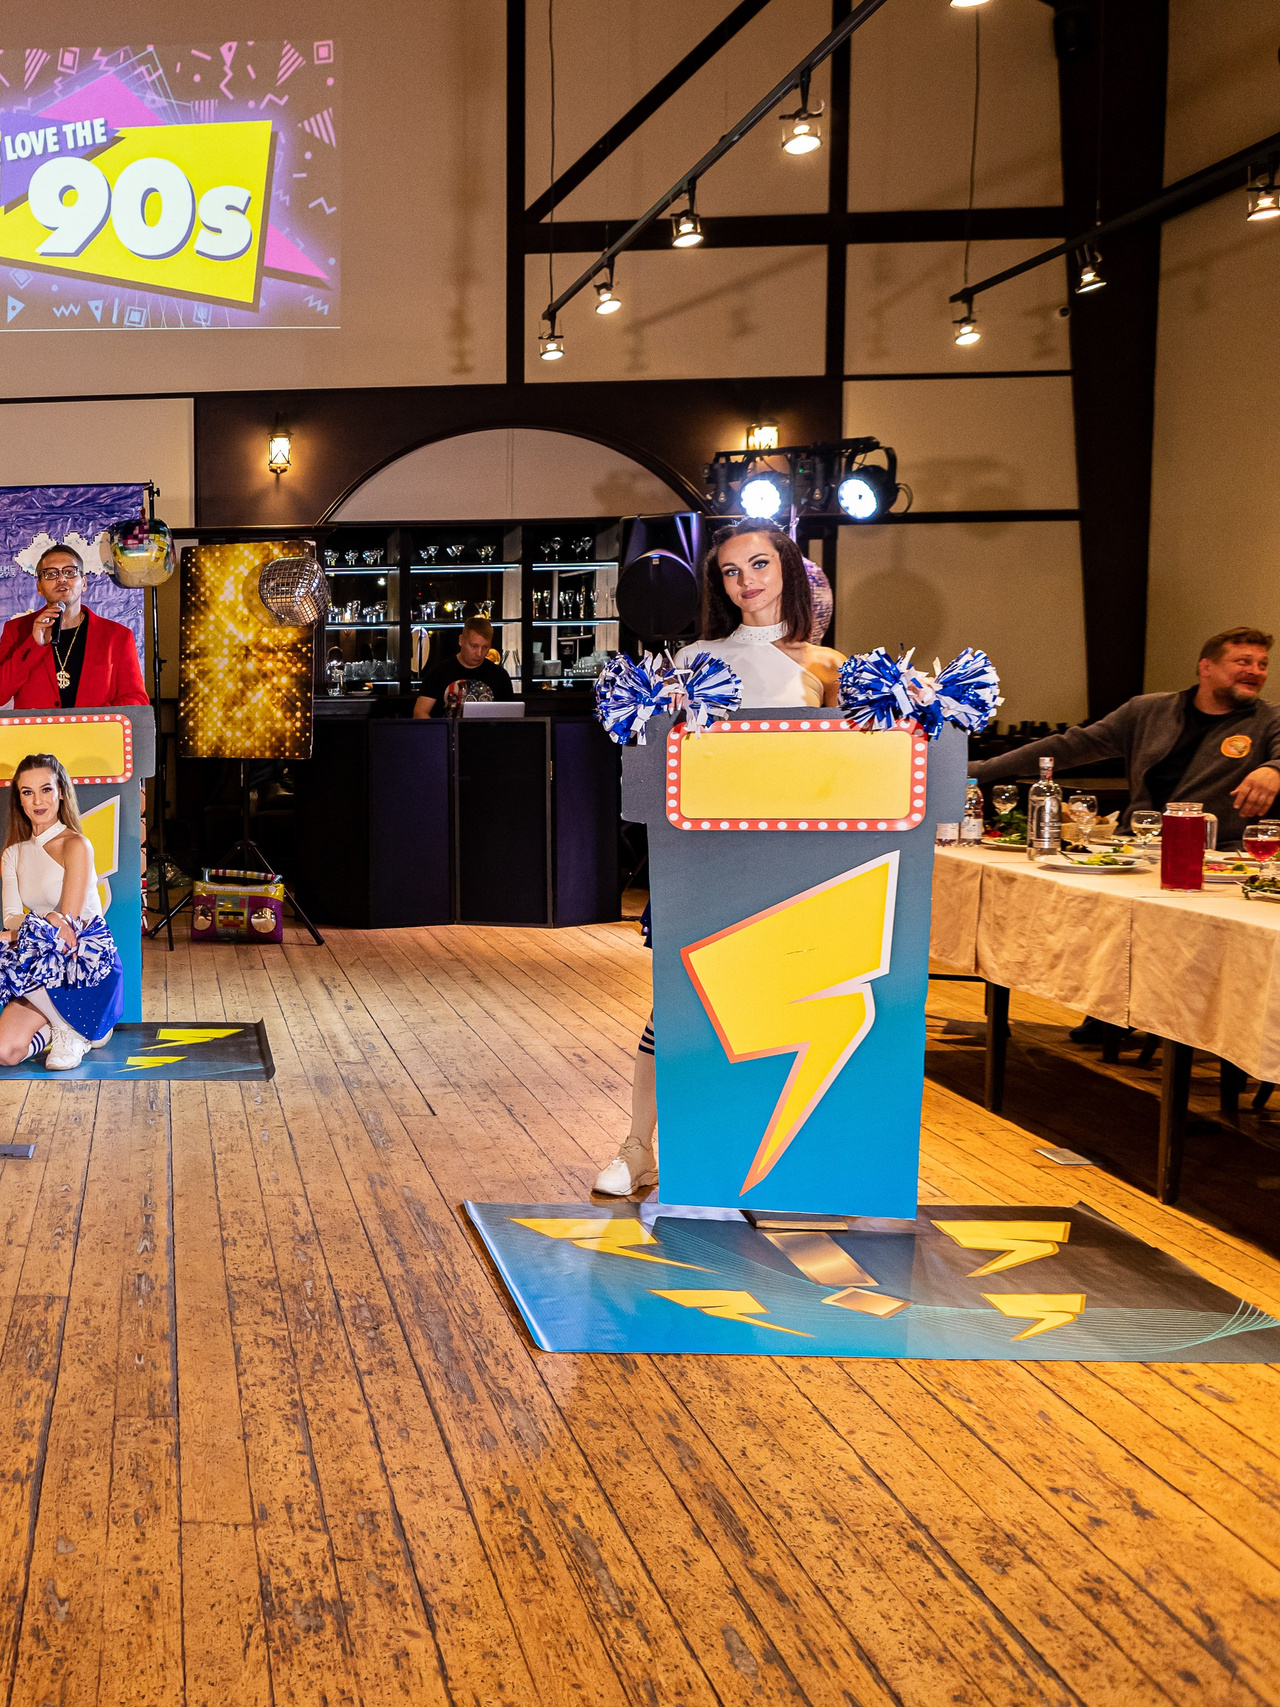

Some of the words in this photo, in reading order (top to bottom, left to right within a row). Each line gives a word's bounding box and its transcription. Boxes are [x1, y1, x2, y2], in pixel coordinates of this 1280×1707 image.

[4, 126, 59, 161] LOVE
[62, 117, 107, 149] THE
[28, 156, 252, 261] 90s
